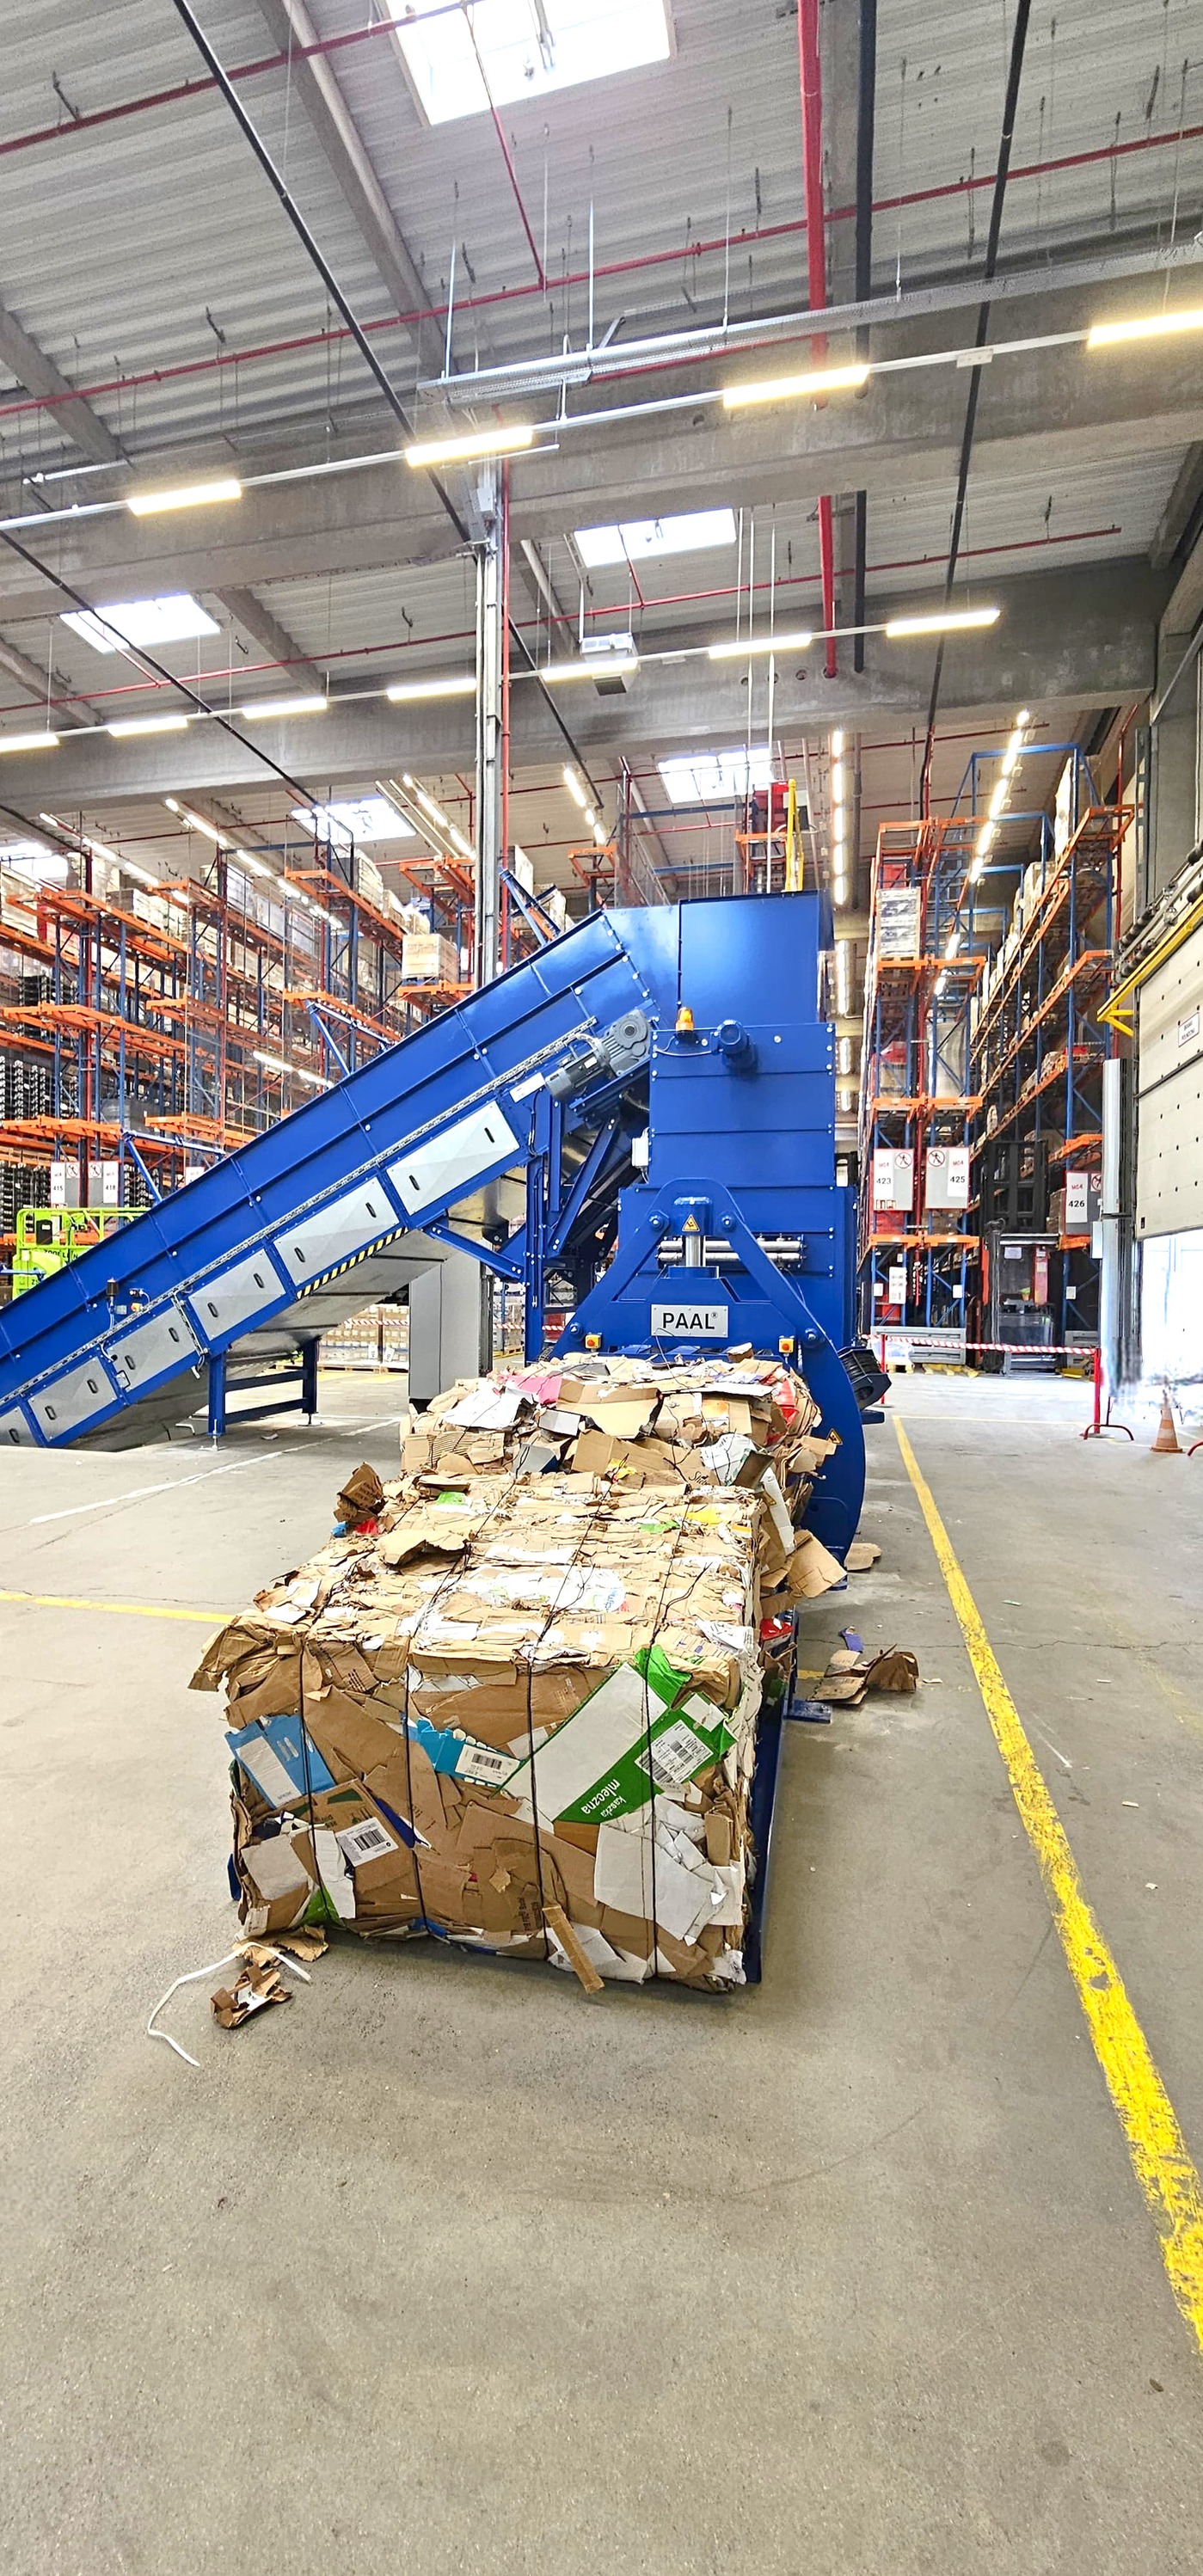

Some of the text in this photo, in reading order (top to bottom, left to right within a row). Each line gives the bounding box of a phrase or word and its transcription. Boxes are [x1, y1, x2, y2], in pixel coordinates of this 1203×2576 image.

[1068, 1199, 1085, 1208] 426
[580, 1778, 620, 1814] mleczna
[600, 1795, 627, 1818] kaszka
